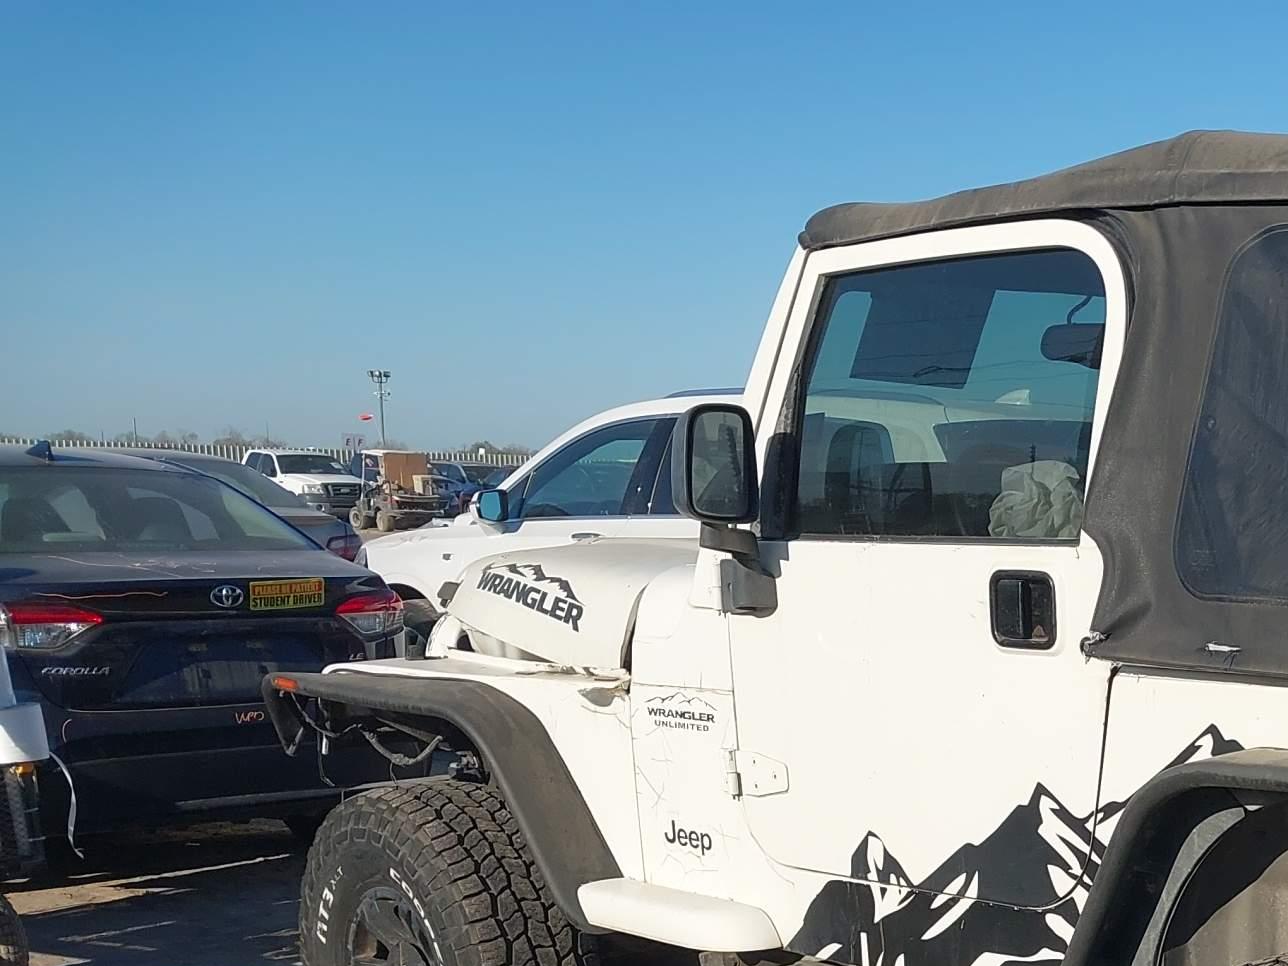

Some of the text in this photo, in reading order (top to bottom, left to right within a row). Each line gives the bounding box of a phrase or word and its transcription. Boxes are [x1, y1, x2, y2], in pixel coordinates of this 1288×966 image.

[252, 592, 321, 608] STUDENT DRIVER
[476, 571, 584, 632] WRANGLER
[41, 666, 110, 676] COROLLA
[647, 706, 716, 723] WRANGLER
[654, 719, 710, 732] UNLIMITED
[664, 819, 712, 856] Jeep
